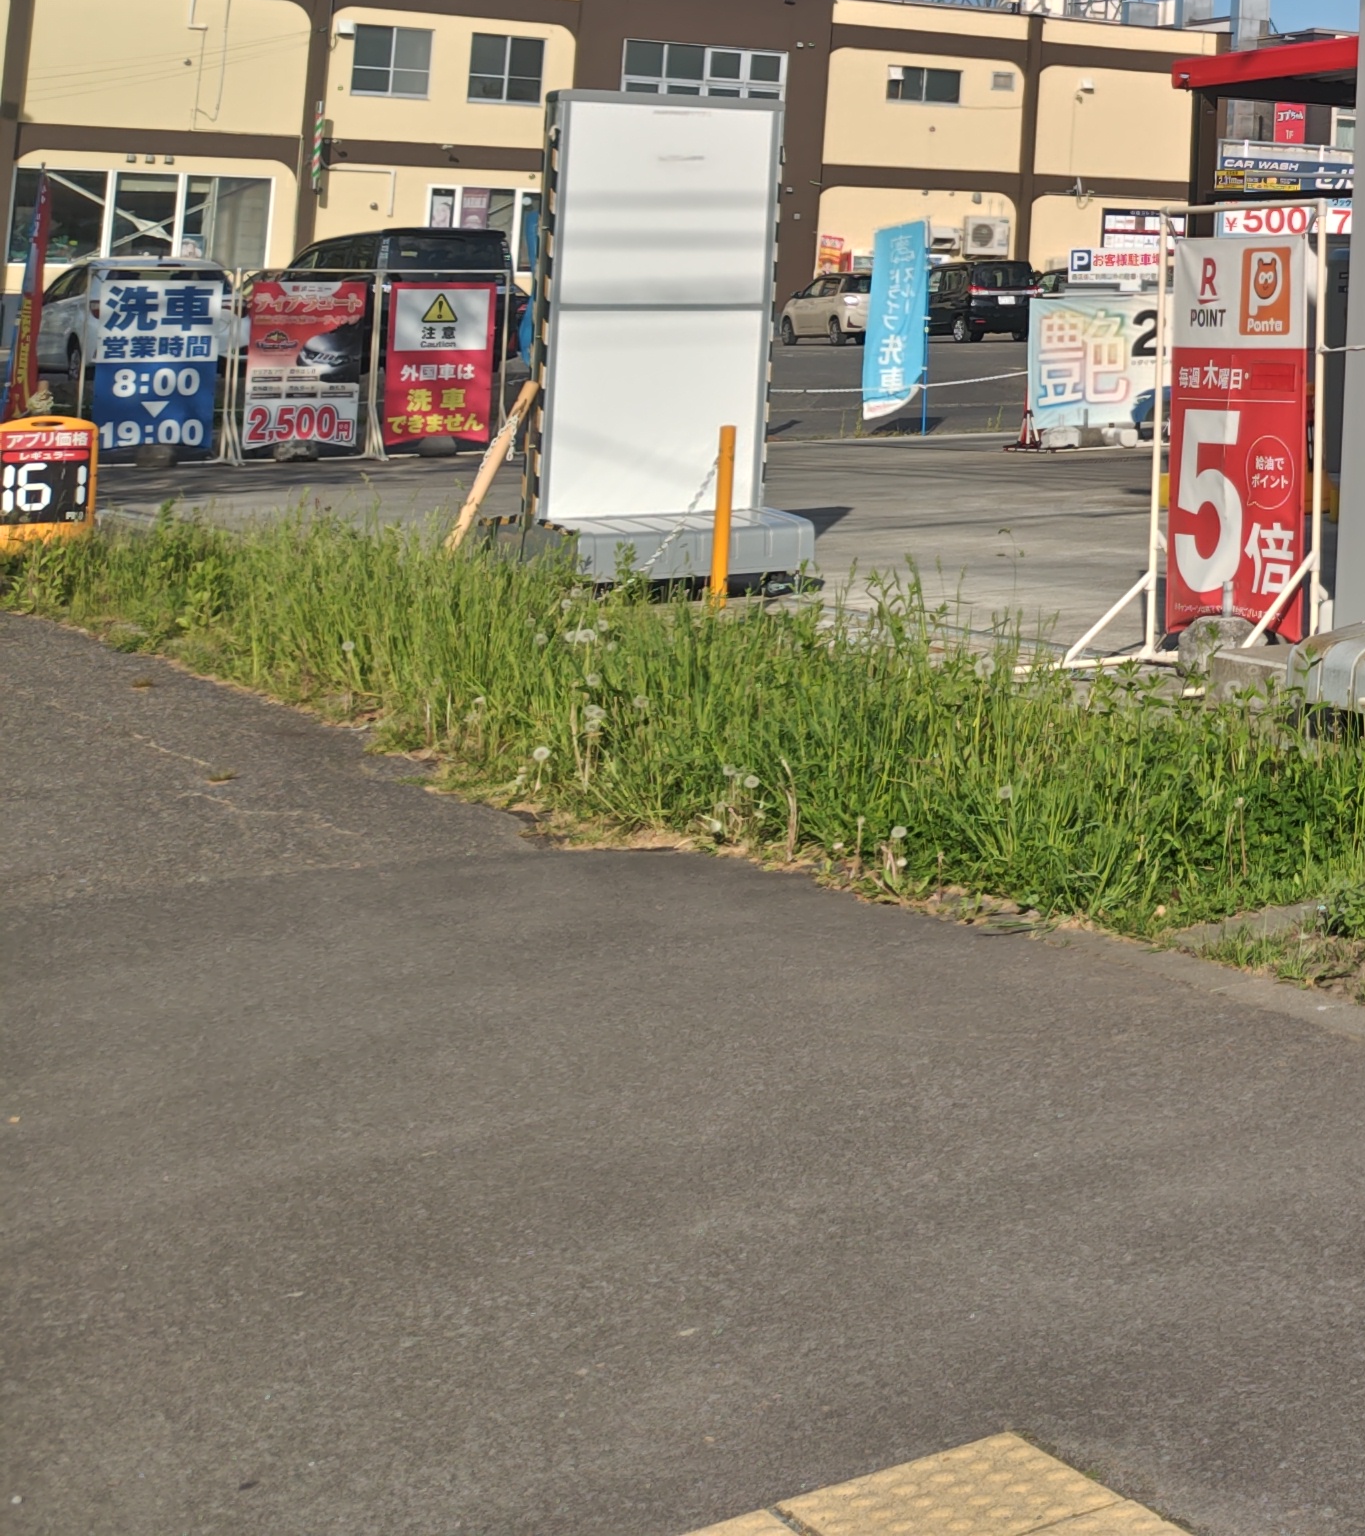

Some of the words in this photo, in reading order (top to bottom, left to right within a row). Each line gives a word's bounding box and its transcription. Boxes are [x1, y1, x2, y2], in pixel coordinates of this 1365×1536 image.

[1224, 159, 1255, 168] CAR
[1258, 160, 1300, 172] WASH
[104, 286, 214, 331] 洗車
[1190, 309, 1226, 328] POINT
[1247, 317, 1283, 333] Ponta
[421, 326, 456, 340] 注意
[103, 336, 212, 359] 営業時間
[401, 364, 475, 381] 外国車は
[112, 368, 200, 397] 8:00
[406, 388, 466, 413] 洗車
[246, 405, 355, 442] 2,500円
[387, 415, 484, 434] できません
[6, 431, 88, 449] アプリ価格
[100, 419, 204, 449] 19:00
[19, 452, 75, 461] レギュラー
[1255, 455, 1285, 471] 給油で
[2, 463, 88, 514] 161
[1252, 473, 1288, 489] ポイント
[1174, 408, 1243, 593] 5
[1244, 522, 1294, 595] 倍
